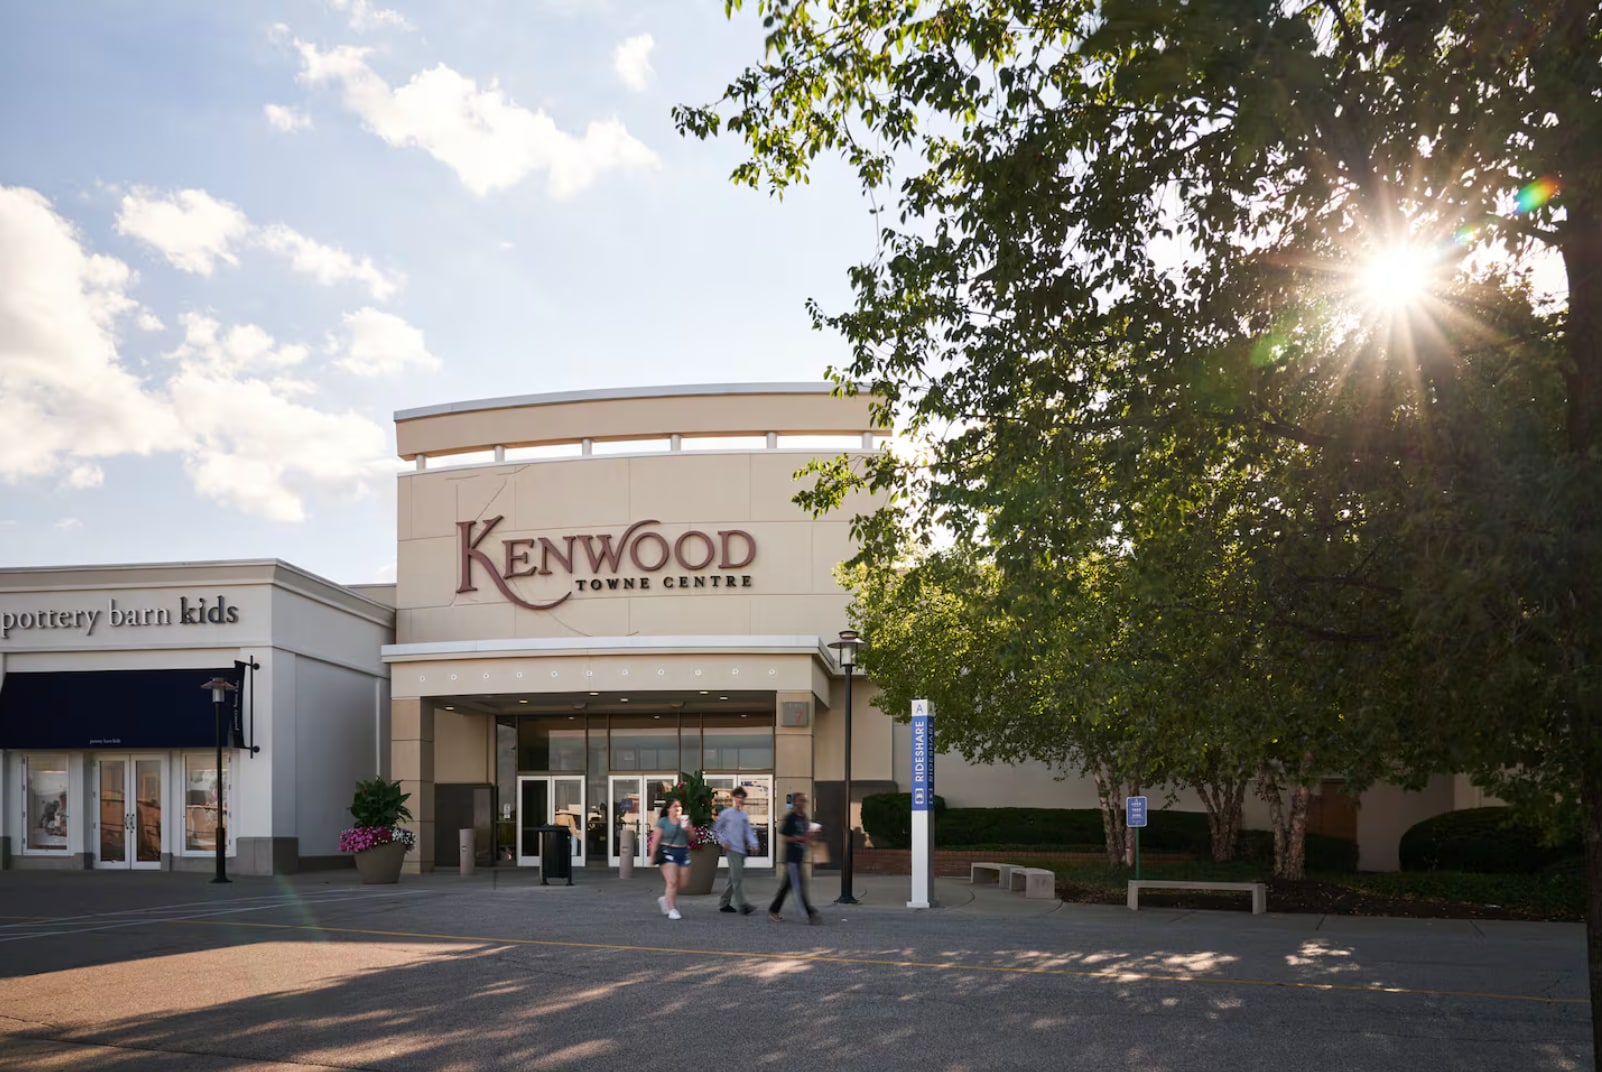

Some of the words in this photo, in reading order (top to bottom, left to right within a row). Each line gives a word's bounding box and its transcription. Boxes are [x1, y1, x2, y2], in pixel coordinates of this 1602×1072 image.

[456, 515, 757, 610] KENWOOD
[575, 577, 651, 592] TOWNE
[663, 575, 753, 589] CENTRE
[0, 609, 102, 640] pottery
[108, 598, 172, 628] barn
[179, 595, 240, 625] kids
[916, 703, 923, 713] A
[915, 721, 925, 782] RIDESHARE
